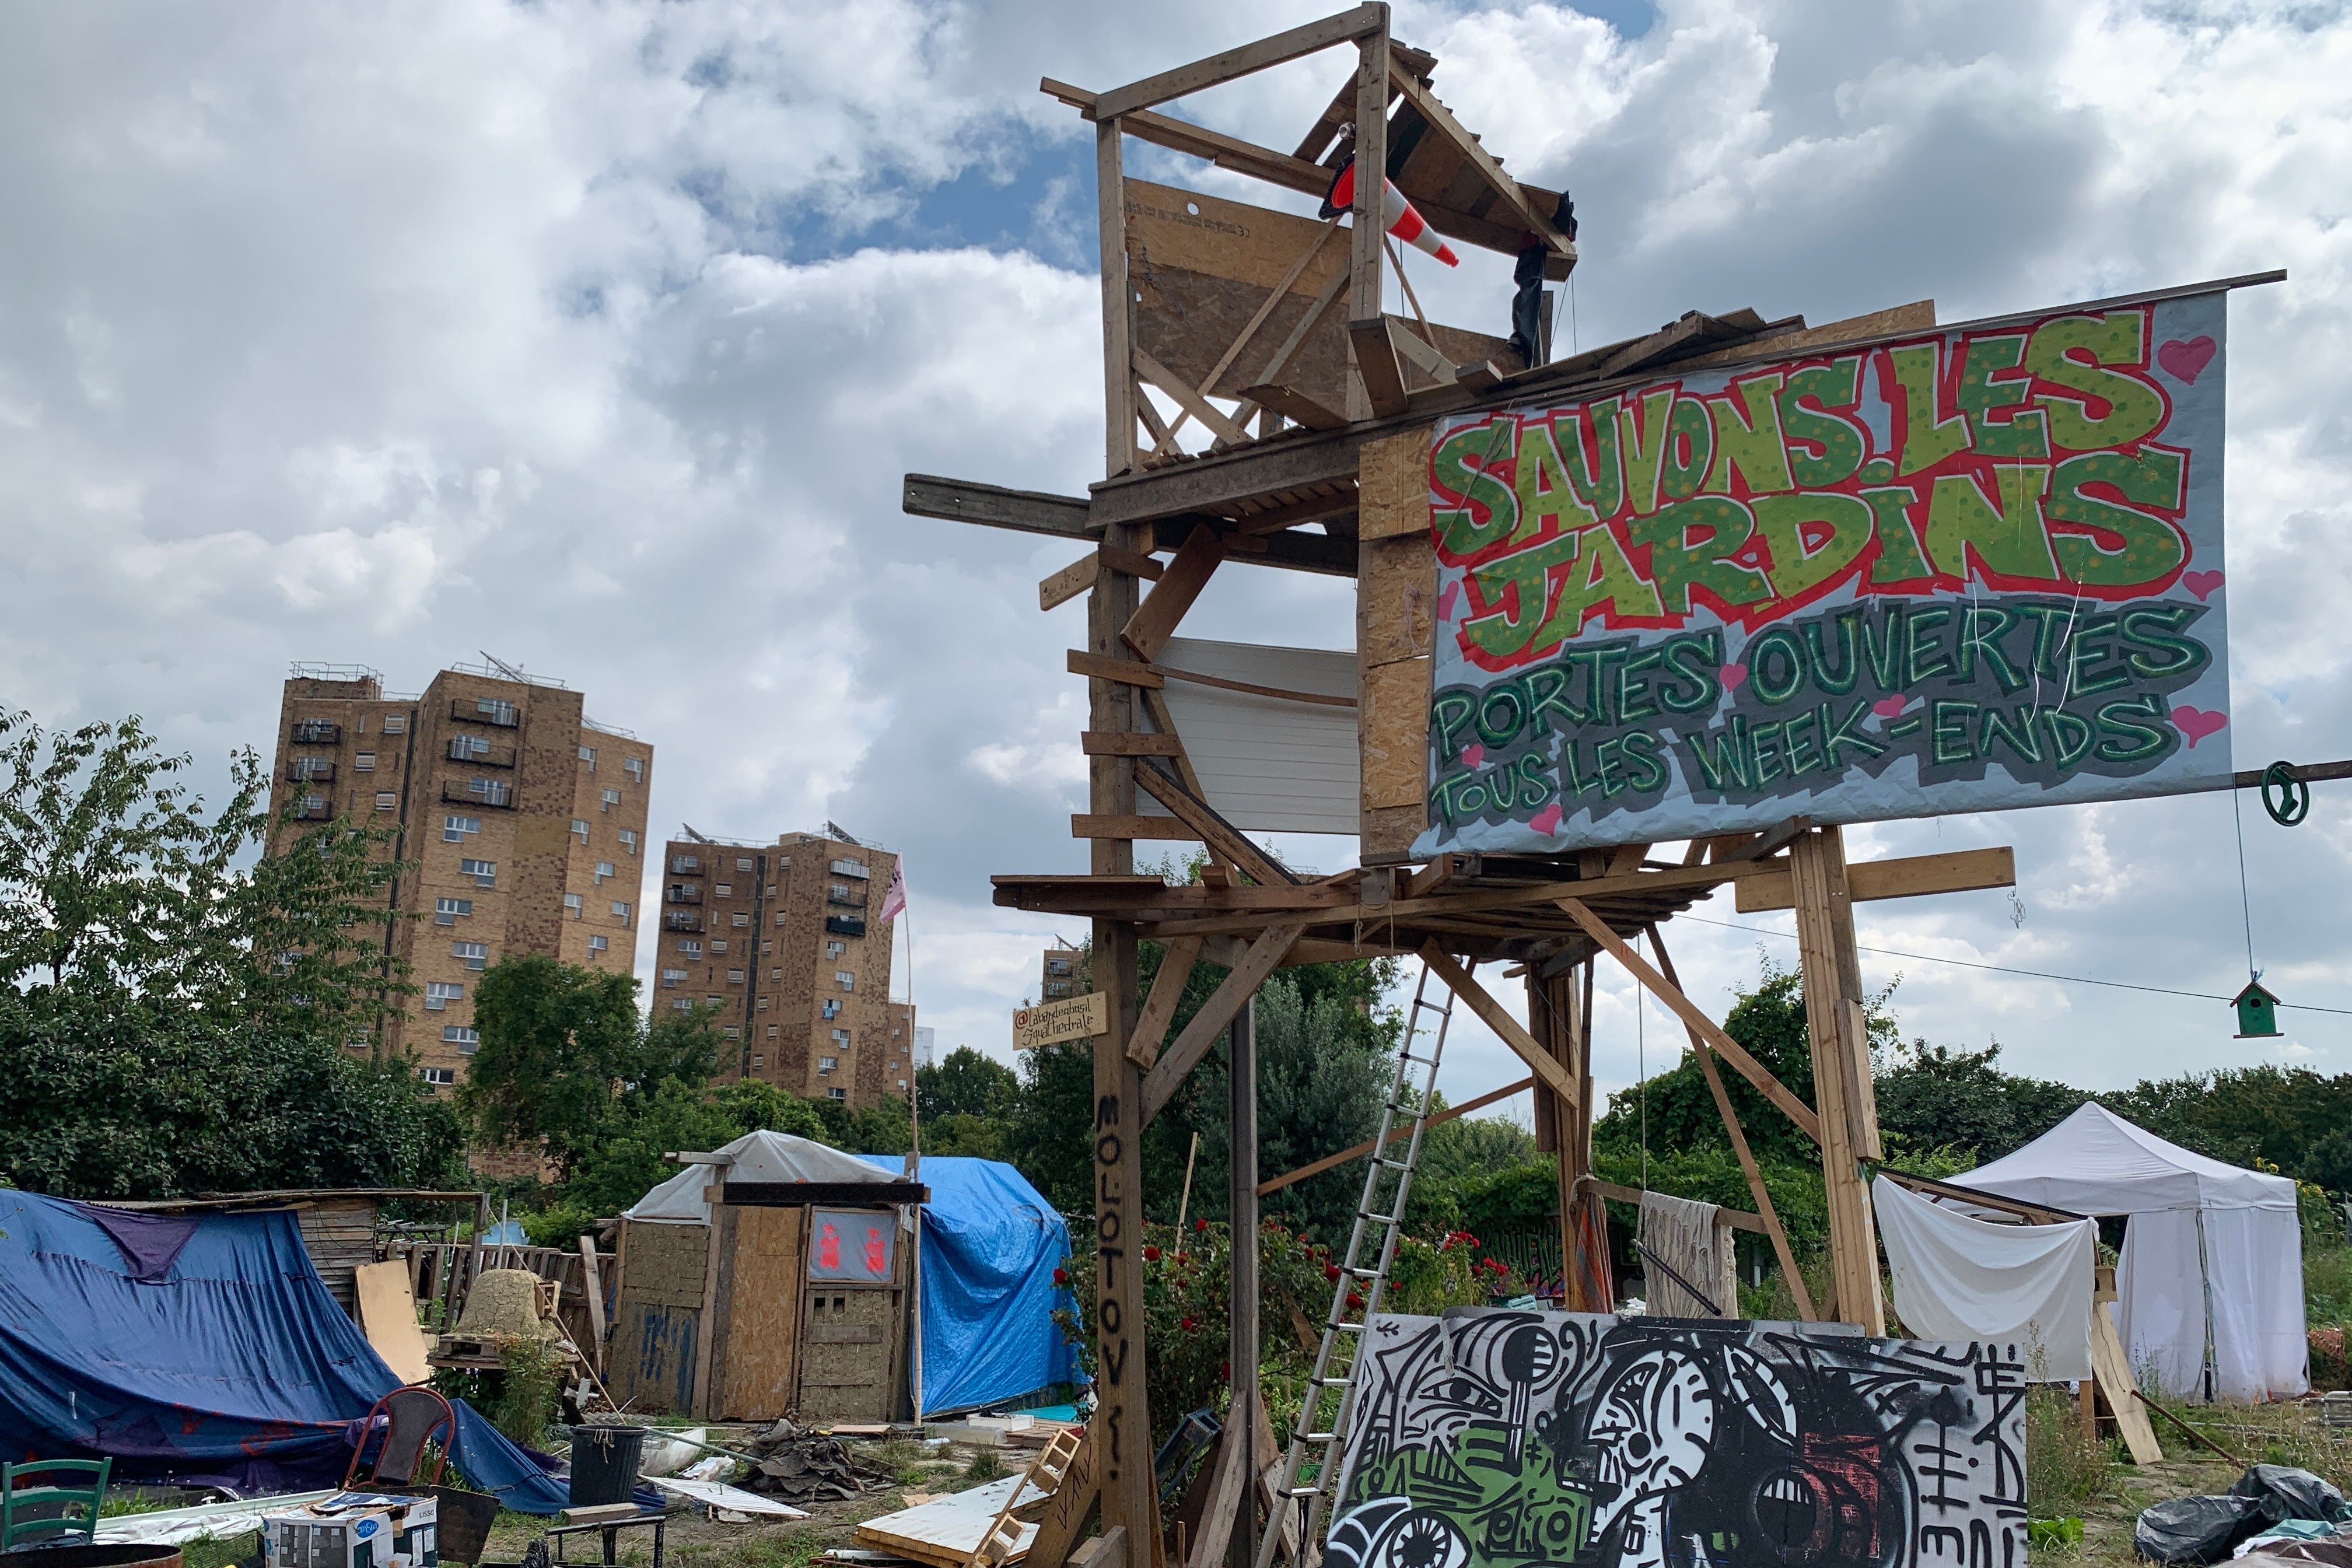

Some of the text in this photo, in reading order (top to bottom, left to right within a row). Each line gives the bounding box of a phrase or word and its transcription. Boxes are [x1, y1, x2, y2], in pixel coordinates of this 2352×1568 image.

[1888, 308, 2167, 478] LES
[1463, 443, 2187, 658] JARDINS
[1430, 600, 2207, 770] PORTES OUVERTES
[1431, 694, 2174, 827] TOUS LES WEEK-ENDS
[419, 1509, 435, 1518] LISSO
